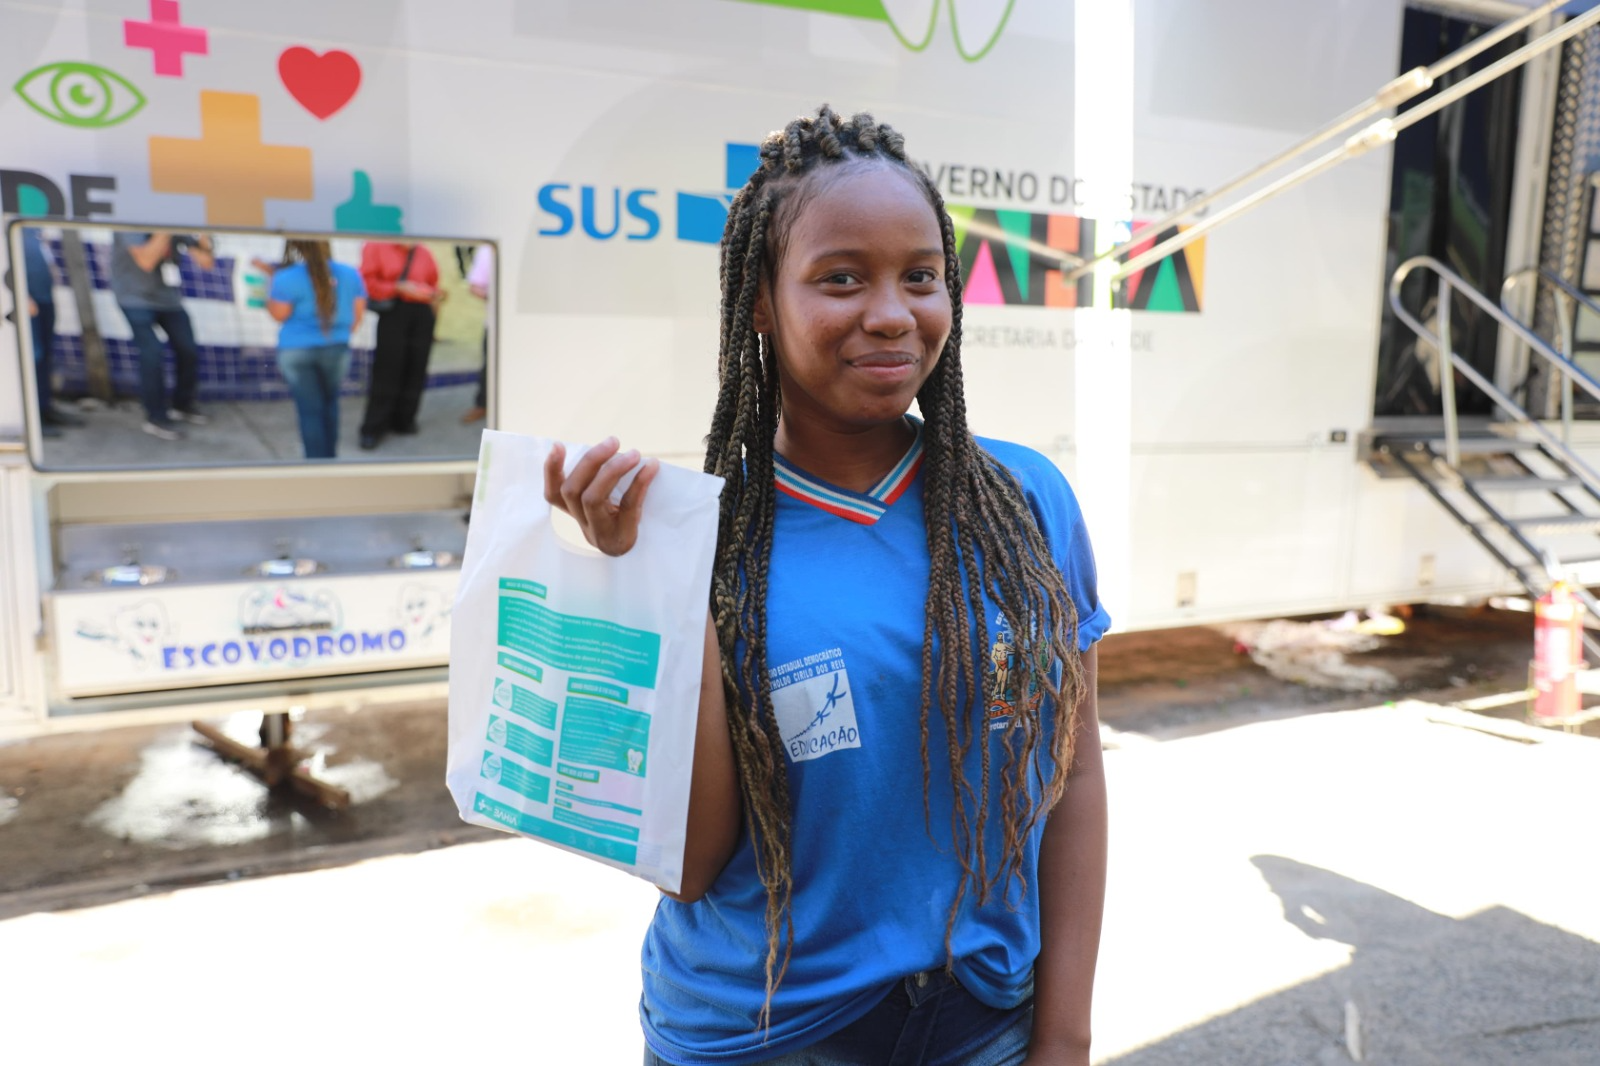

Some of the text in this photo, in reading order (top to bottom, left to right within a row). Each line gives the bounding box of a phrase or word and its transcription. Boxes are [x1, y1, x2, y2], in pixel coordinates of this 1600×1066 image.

[918, 163, 1038, 202] VERNO
[537, 183, 661, 240] SUS
[961, 323, 1058, 348] CRETARIA
[163, 629, 405, 668] ESCOVODROMO
[777, 658, 804, 676] ESTADUAL
[803, 647, 842, 667] DEMOCRÁTICO
[793, 668, 814, 682] CIRILO
[815, 663, 829, 675] DOS
[830, 658, 846, 670] REIS
